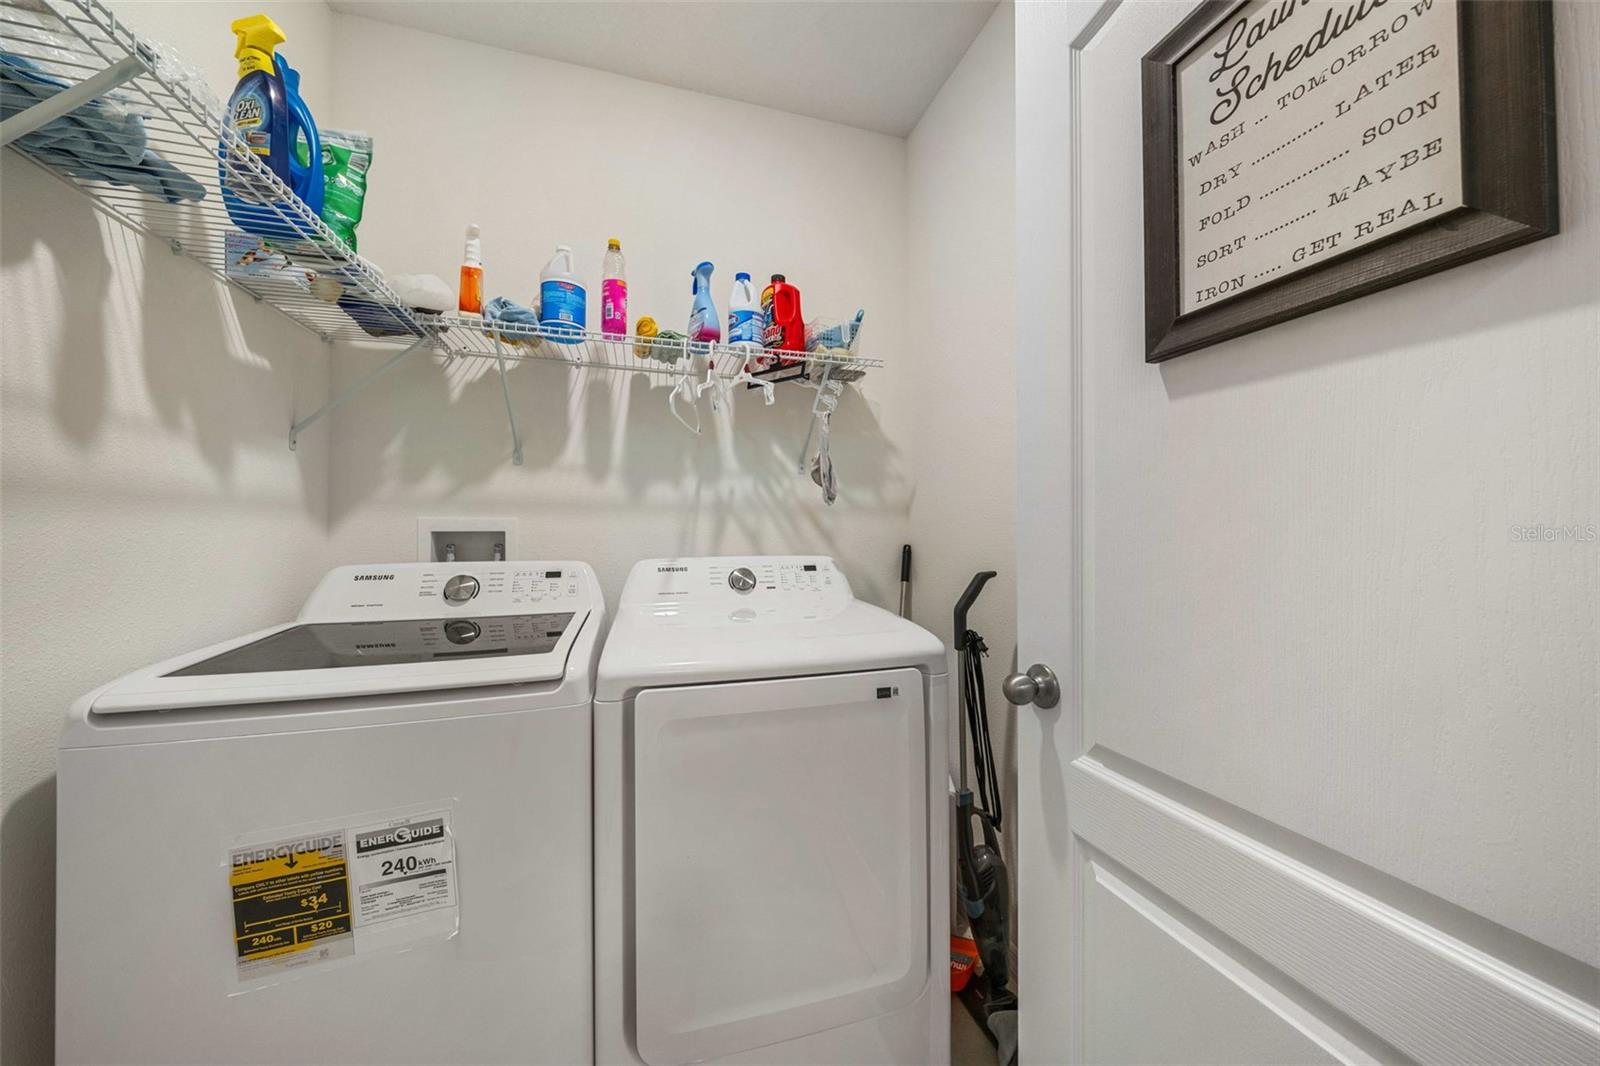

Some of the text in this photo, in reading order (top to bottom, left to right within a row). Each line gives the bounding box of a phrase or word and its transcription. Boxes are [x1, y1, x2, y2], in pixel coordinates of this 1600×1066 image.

[1210, 0, 1388, 125] Schedul
[1188, 0, 1433, 167] WASH TOMORROW
[236, 99, 256, 112] OXI
[1199, 44, 1440, 196] DRY LATER
[1199, 91, 1440, 231] FOLD SOON
[1197, 138, 1442, 268] SORT MAYBE
[1196, 193, 1443, 303] IRON GET REAL
[233, 835, 342, 868] ENERGYGUIDE
[360, 824, 441, 848] ENERGUIDE
[381, 856, 417, 875] 240
[418, 857, 437, 866] kWh
[301, 893, 328, 907] $34
[251, 934, 274, 946] 240
[311, 920, 333, 932] $20
